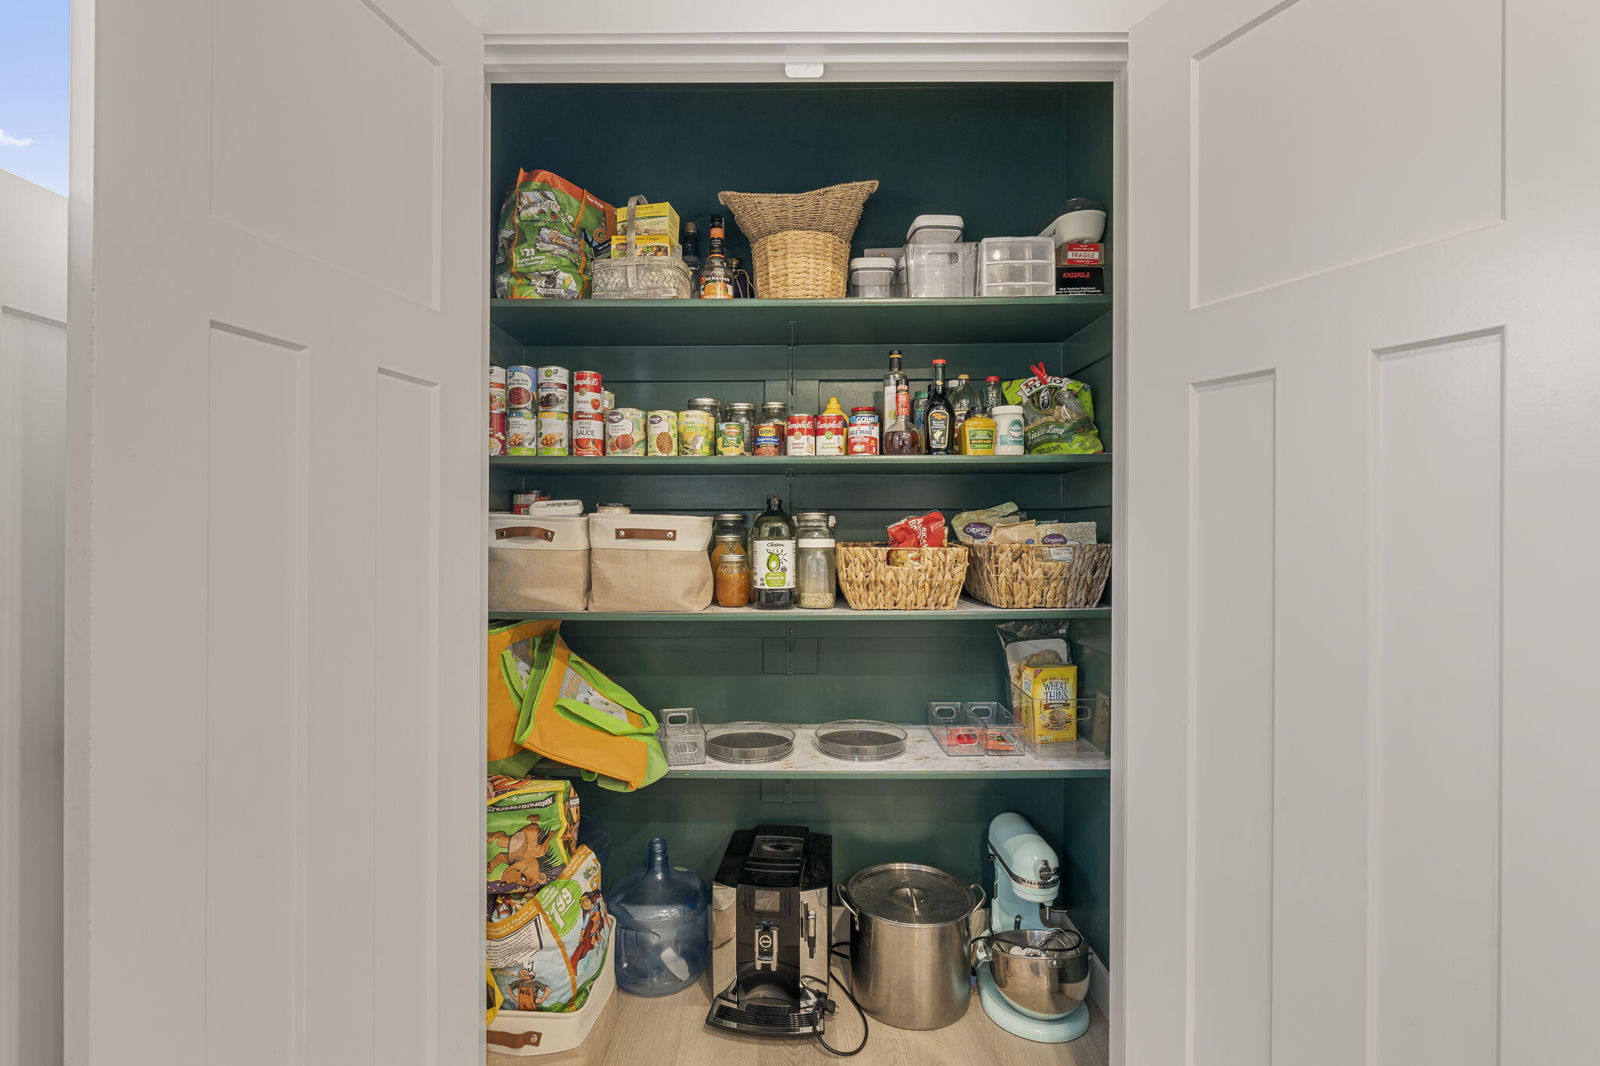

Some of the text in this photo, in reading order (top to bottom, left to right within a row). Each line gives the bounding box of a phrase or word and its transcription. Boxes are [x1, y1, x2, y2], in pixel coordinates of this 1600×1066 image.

[856, 415, 875, 424] GOYA
[575, 429, 596, 437] SAUCE
[1043, 681, 1069, 691] WHEAT
[1043, 690, 1069, 703] THINS
